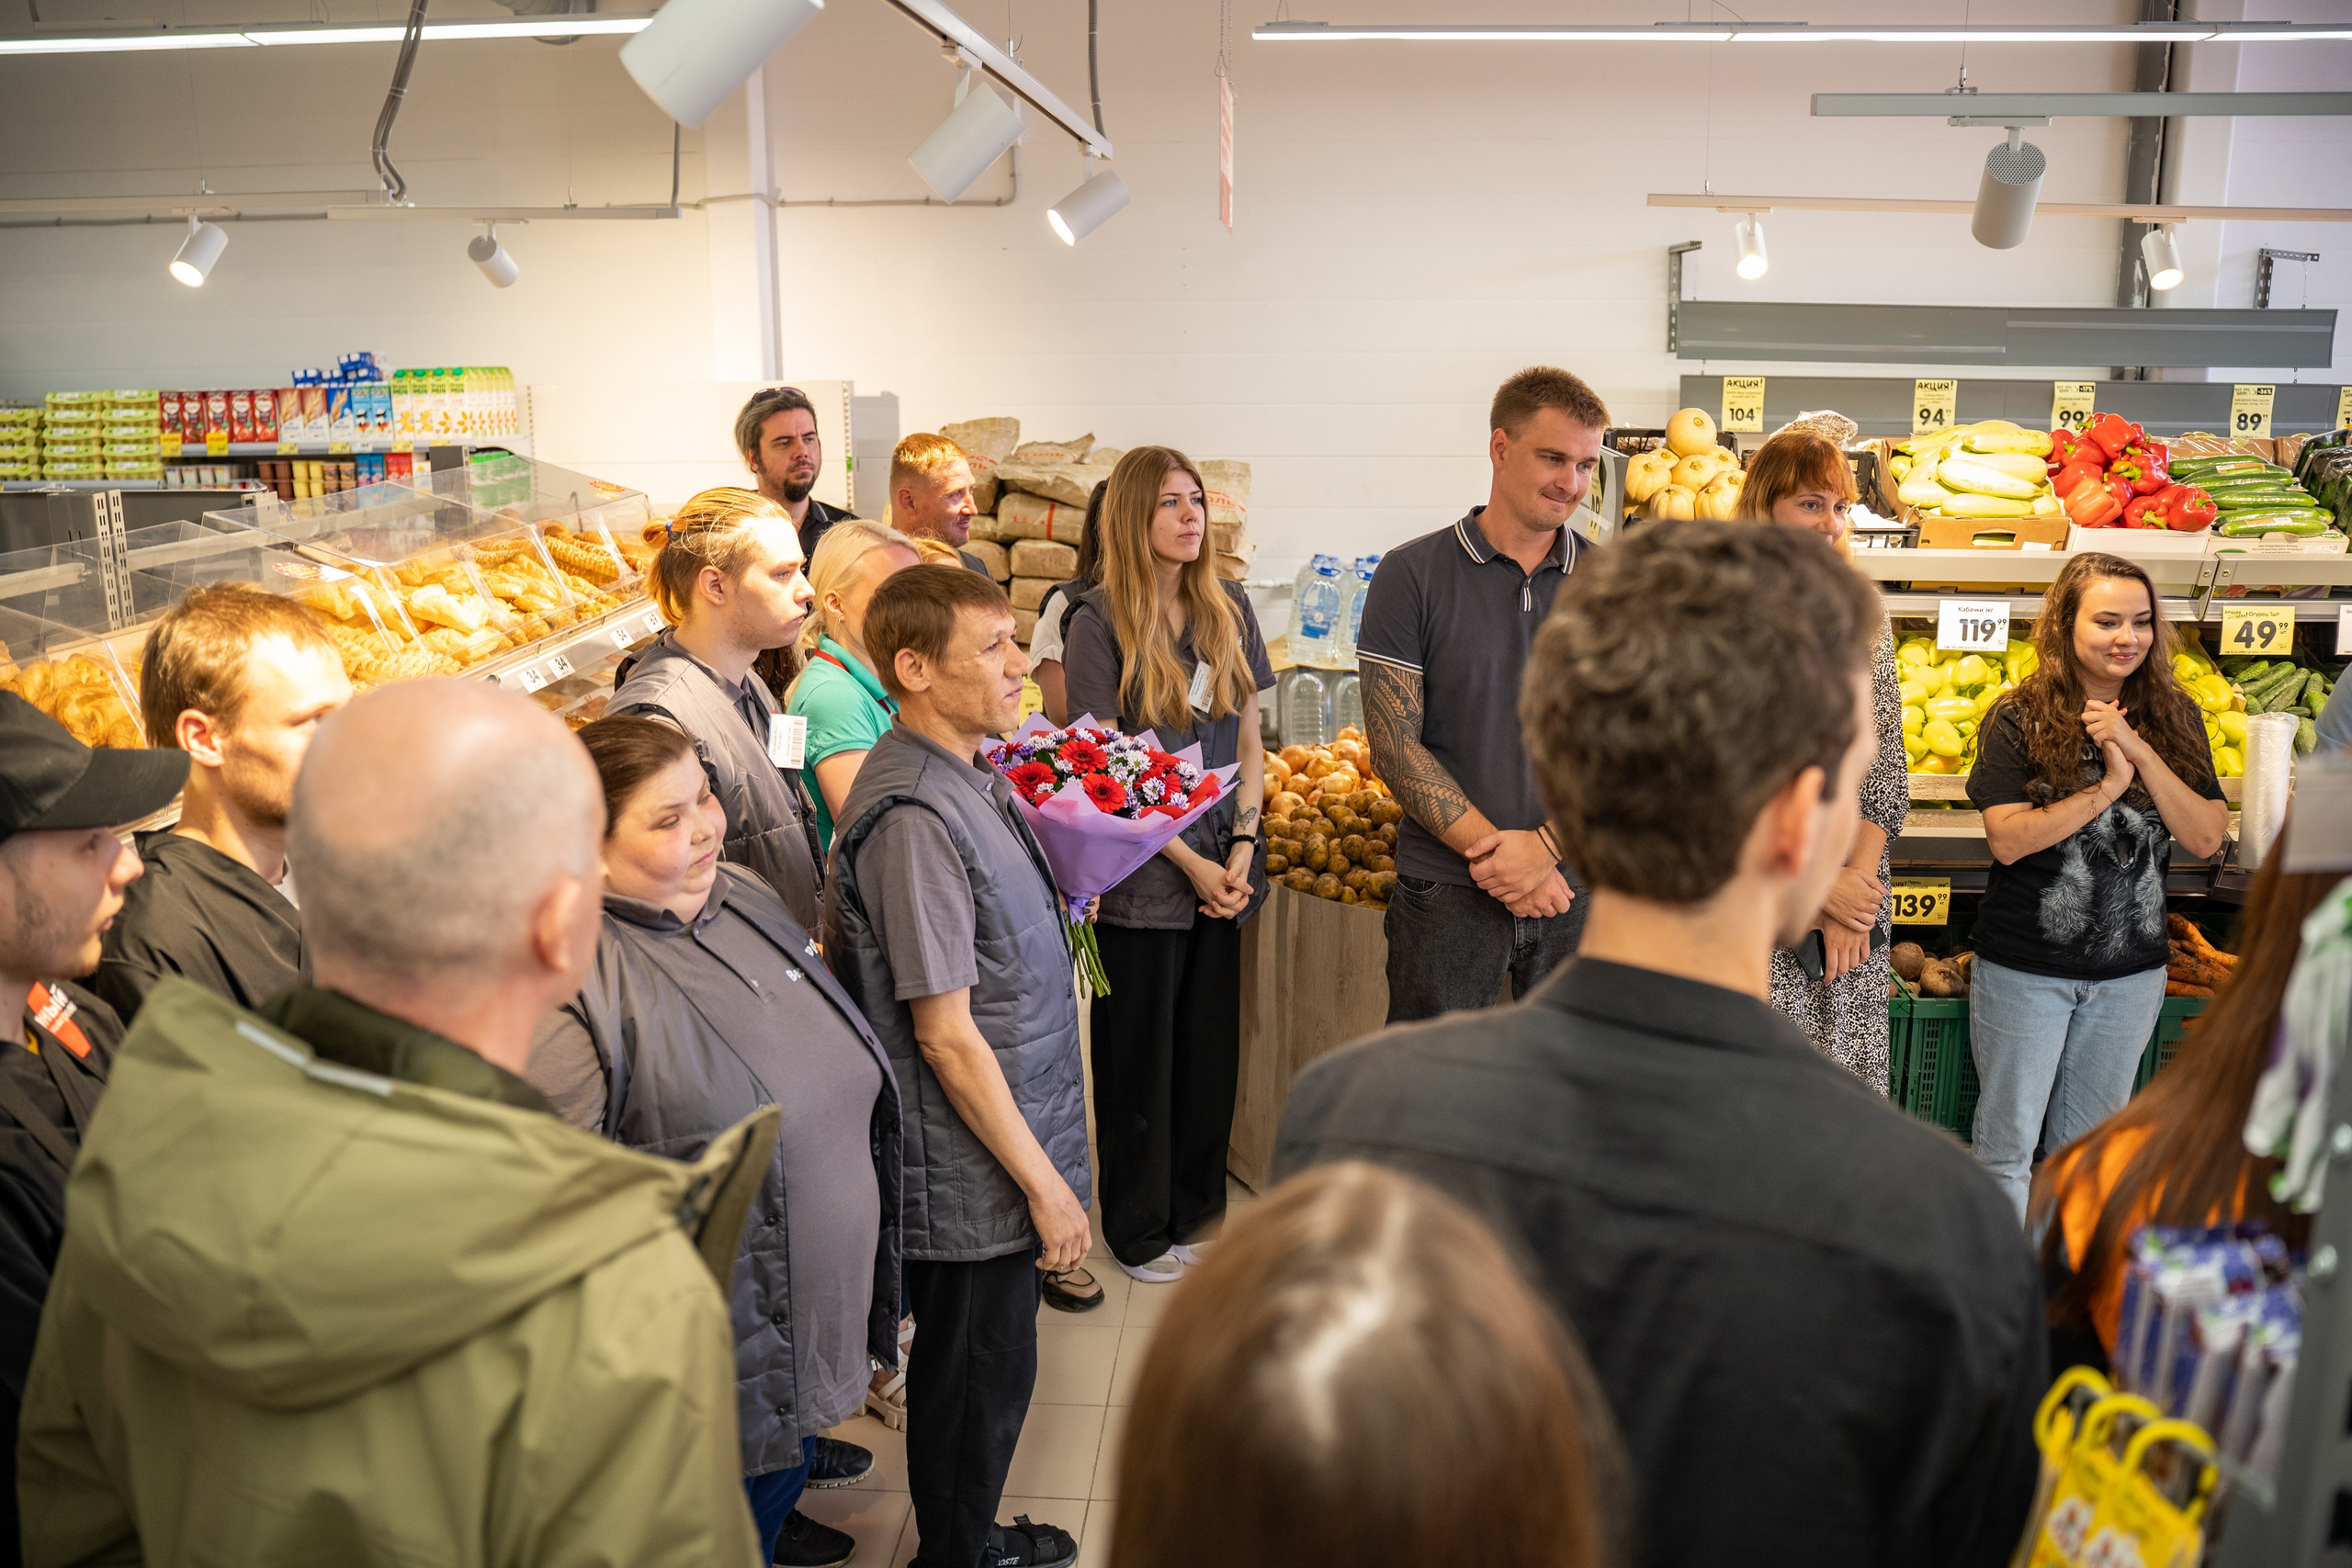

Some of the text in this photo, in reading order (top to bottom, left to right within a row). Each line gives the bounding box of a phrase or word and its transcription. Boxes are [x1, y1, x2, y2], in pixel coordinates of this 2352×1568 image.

[1726, 378, 1763, 389] АКЦИЯ!
[1917, 380, 1954, 391] АКЦИЯ!
[1729, 408, 1755, 422] 104
[1919, 408, 1945, 426] 94
[2059, 410, 2085, 428] 99
[2236, 412, 2262, 431] 89
[1959, 618, 1996, 642] 119
[2233, 620, 2278, 649] 49
[555, 656, 569, 671] 34
[526, 669, 540, 683] 34
[1893, 894, 1937, 918] 139
